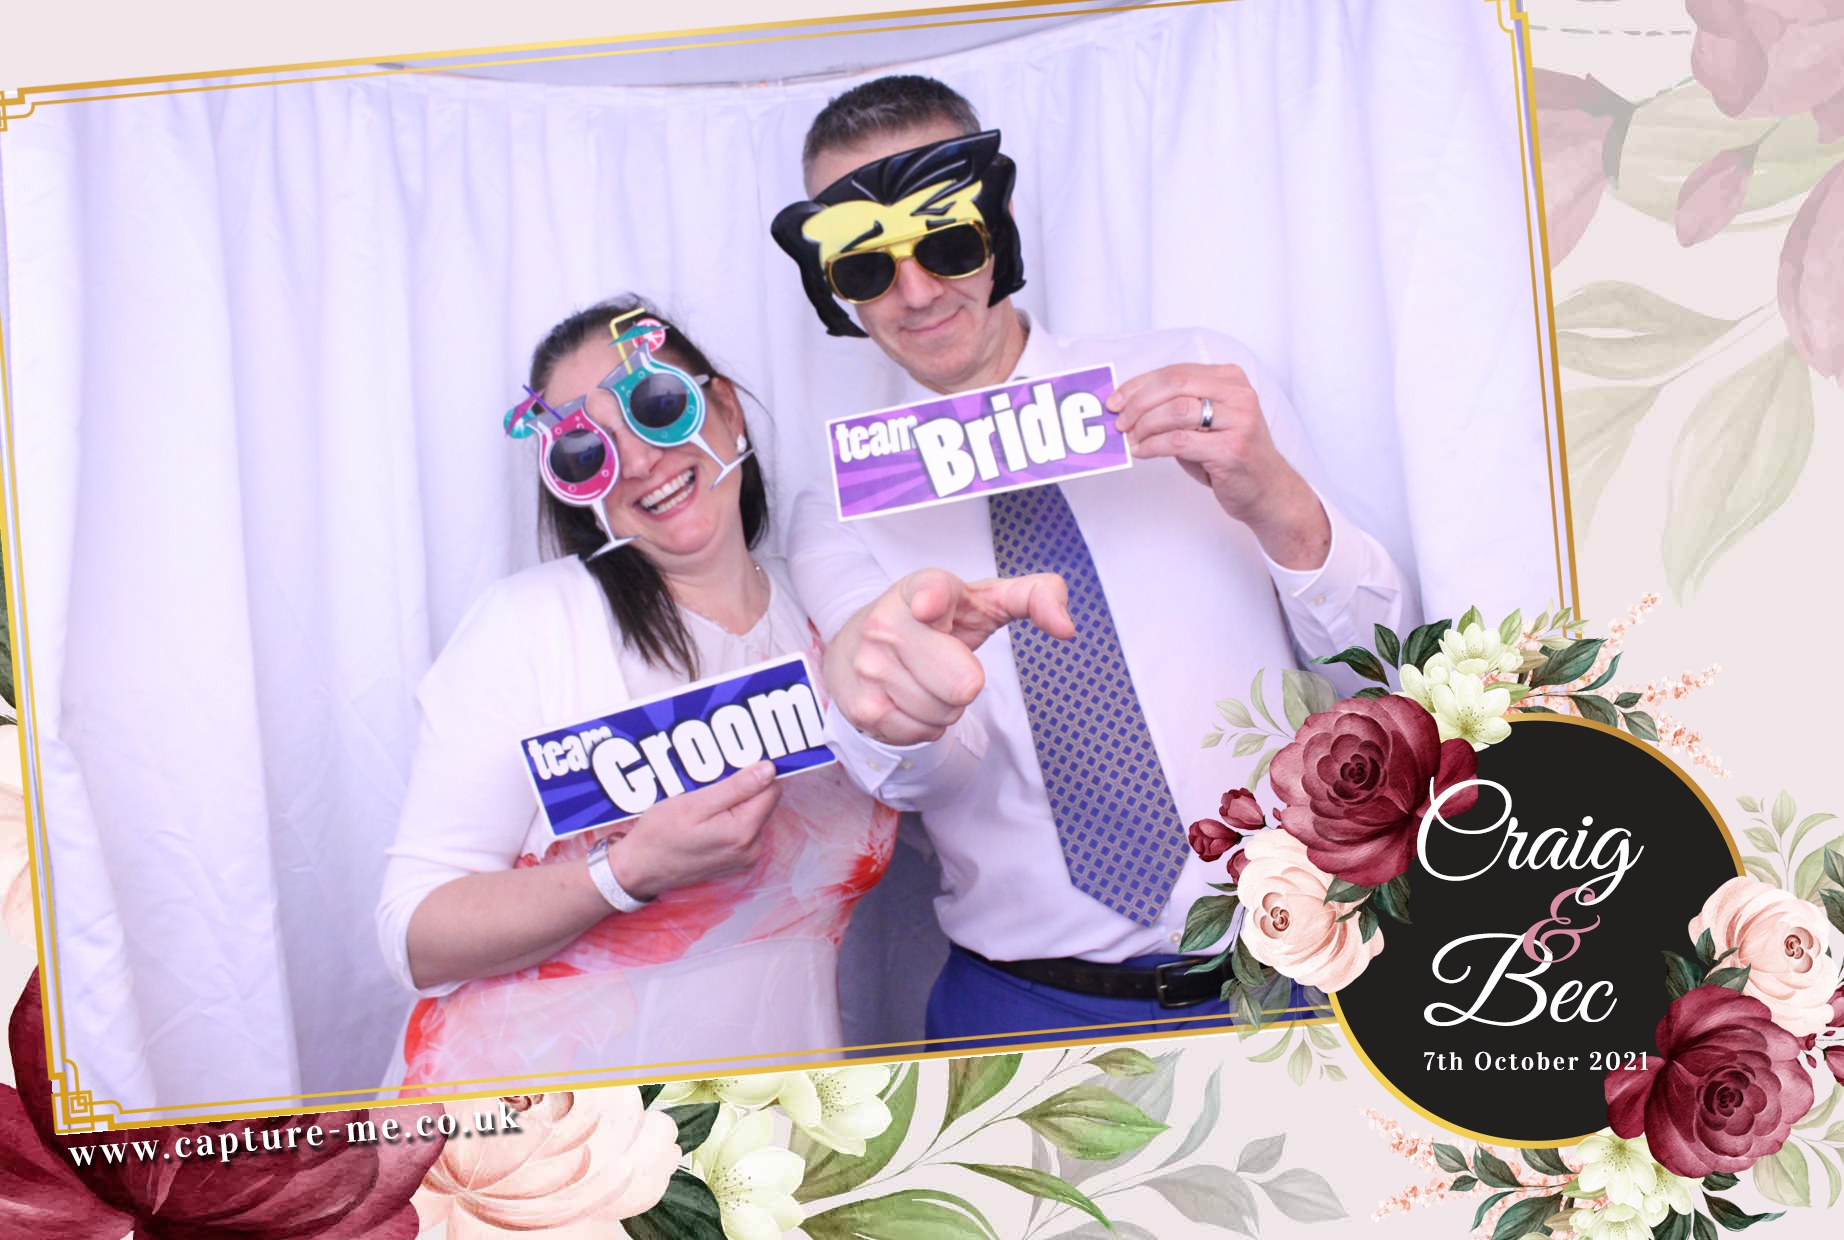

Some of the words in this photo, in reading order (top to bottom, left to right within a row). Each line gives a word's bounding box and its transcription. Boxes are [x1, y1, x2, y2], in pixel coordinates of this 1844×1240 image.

[835, 414, 918, 463] team
[912, 382, 1107, 498] Bride
[592, 683, 824, 814] Groom
